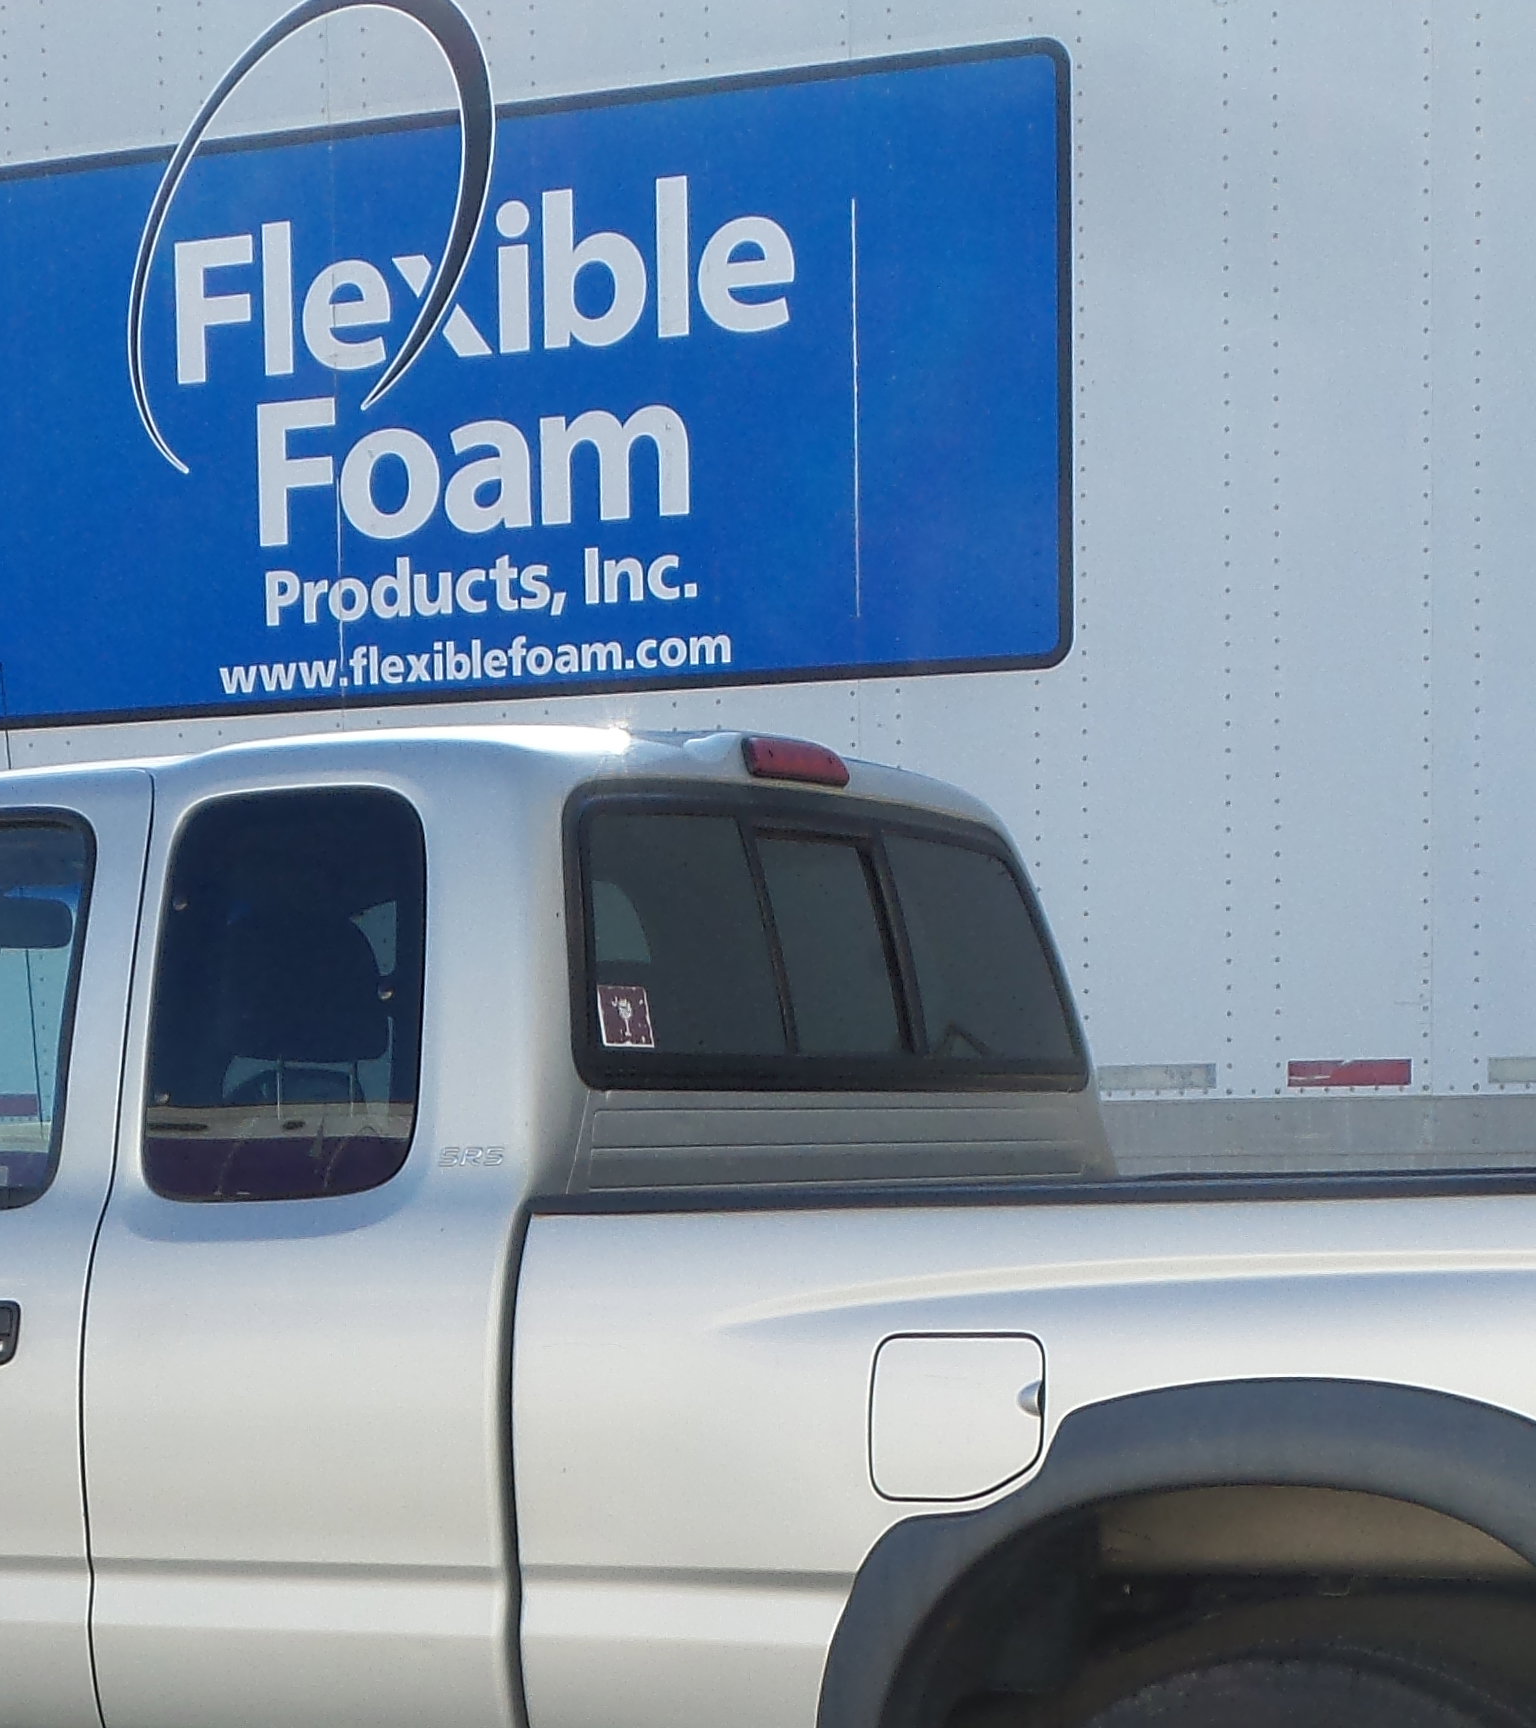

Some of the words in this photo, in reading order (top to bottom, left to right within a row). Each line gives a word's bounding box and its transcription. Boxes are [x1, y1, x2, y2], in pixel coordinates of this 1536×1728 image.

[173, 174, 795, 385] Flexible
[255, 396, 691, 547] Foam
[265, 554, 567, 626] Products,
[583, 546, 699, 605] Inc.
[220, 630, 732, 694] www.flexiblefoam.com
[439, 1146, 505, 1167] SR5
